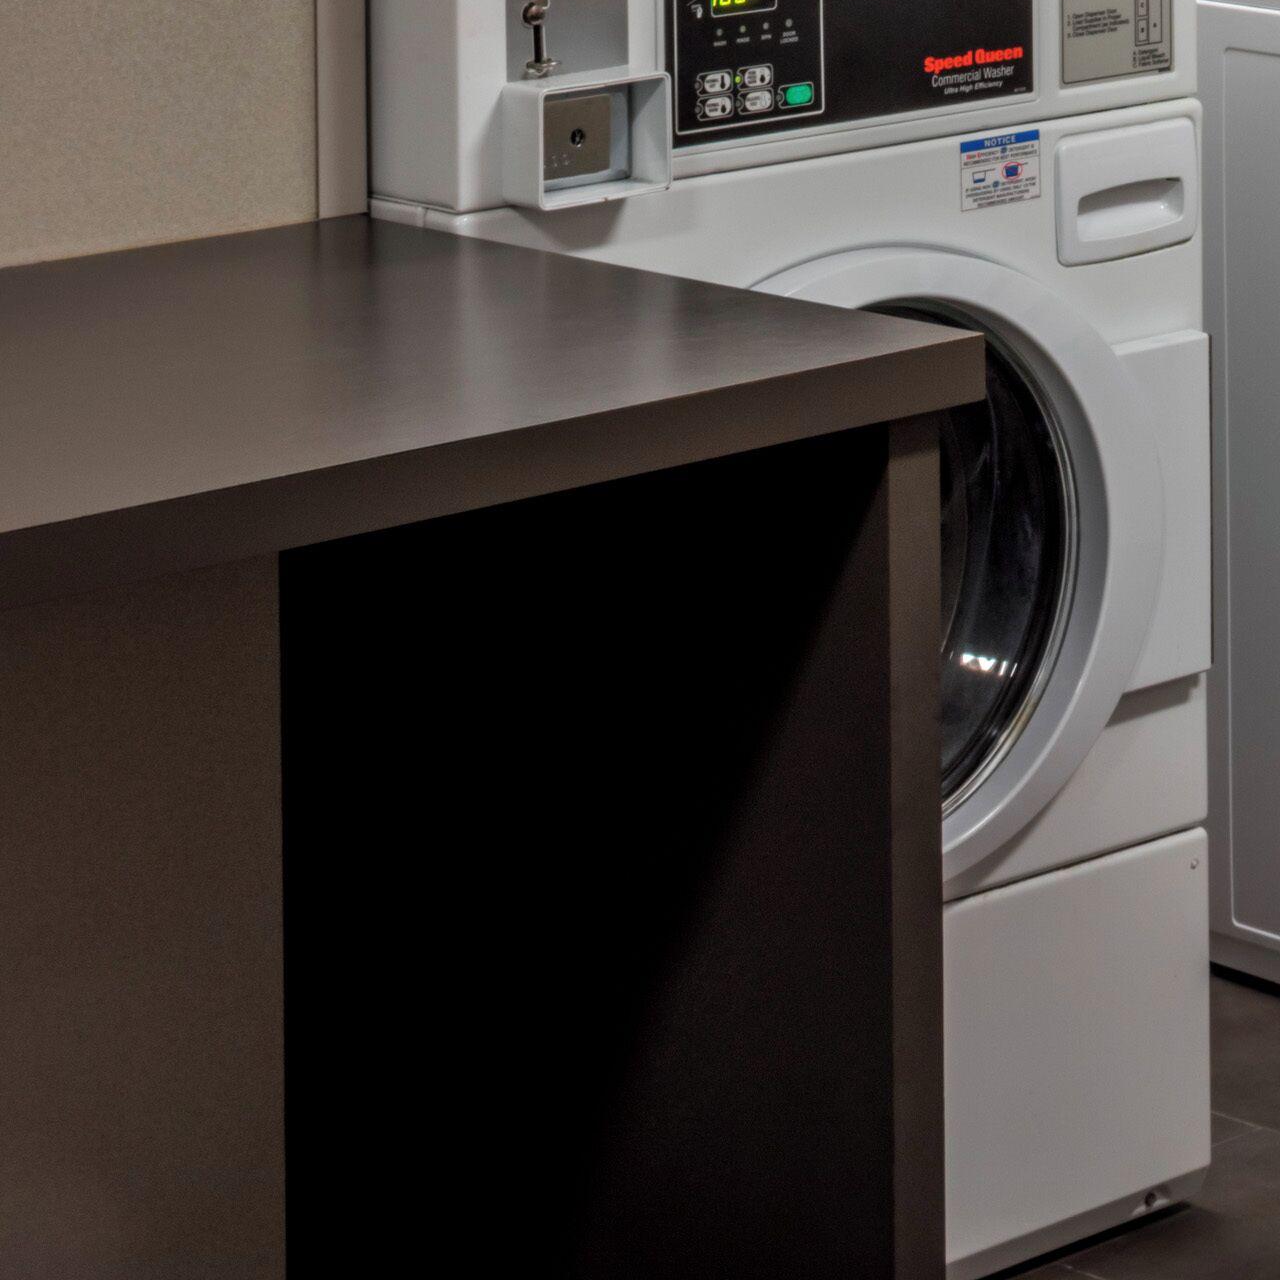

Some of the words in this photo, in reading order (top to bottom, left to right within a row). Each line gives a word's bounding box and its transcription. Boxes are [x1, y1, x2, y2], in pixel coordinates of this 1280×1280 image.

[924, 50, 973, 74] Speed
[975, 47, 1023, 64] Queen
[931, 68, 981, 87] Commercial
[983, 65, 1014, 79] Washer
[984, 135, 1016, 147] NOTICE
